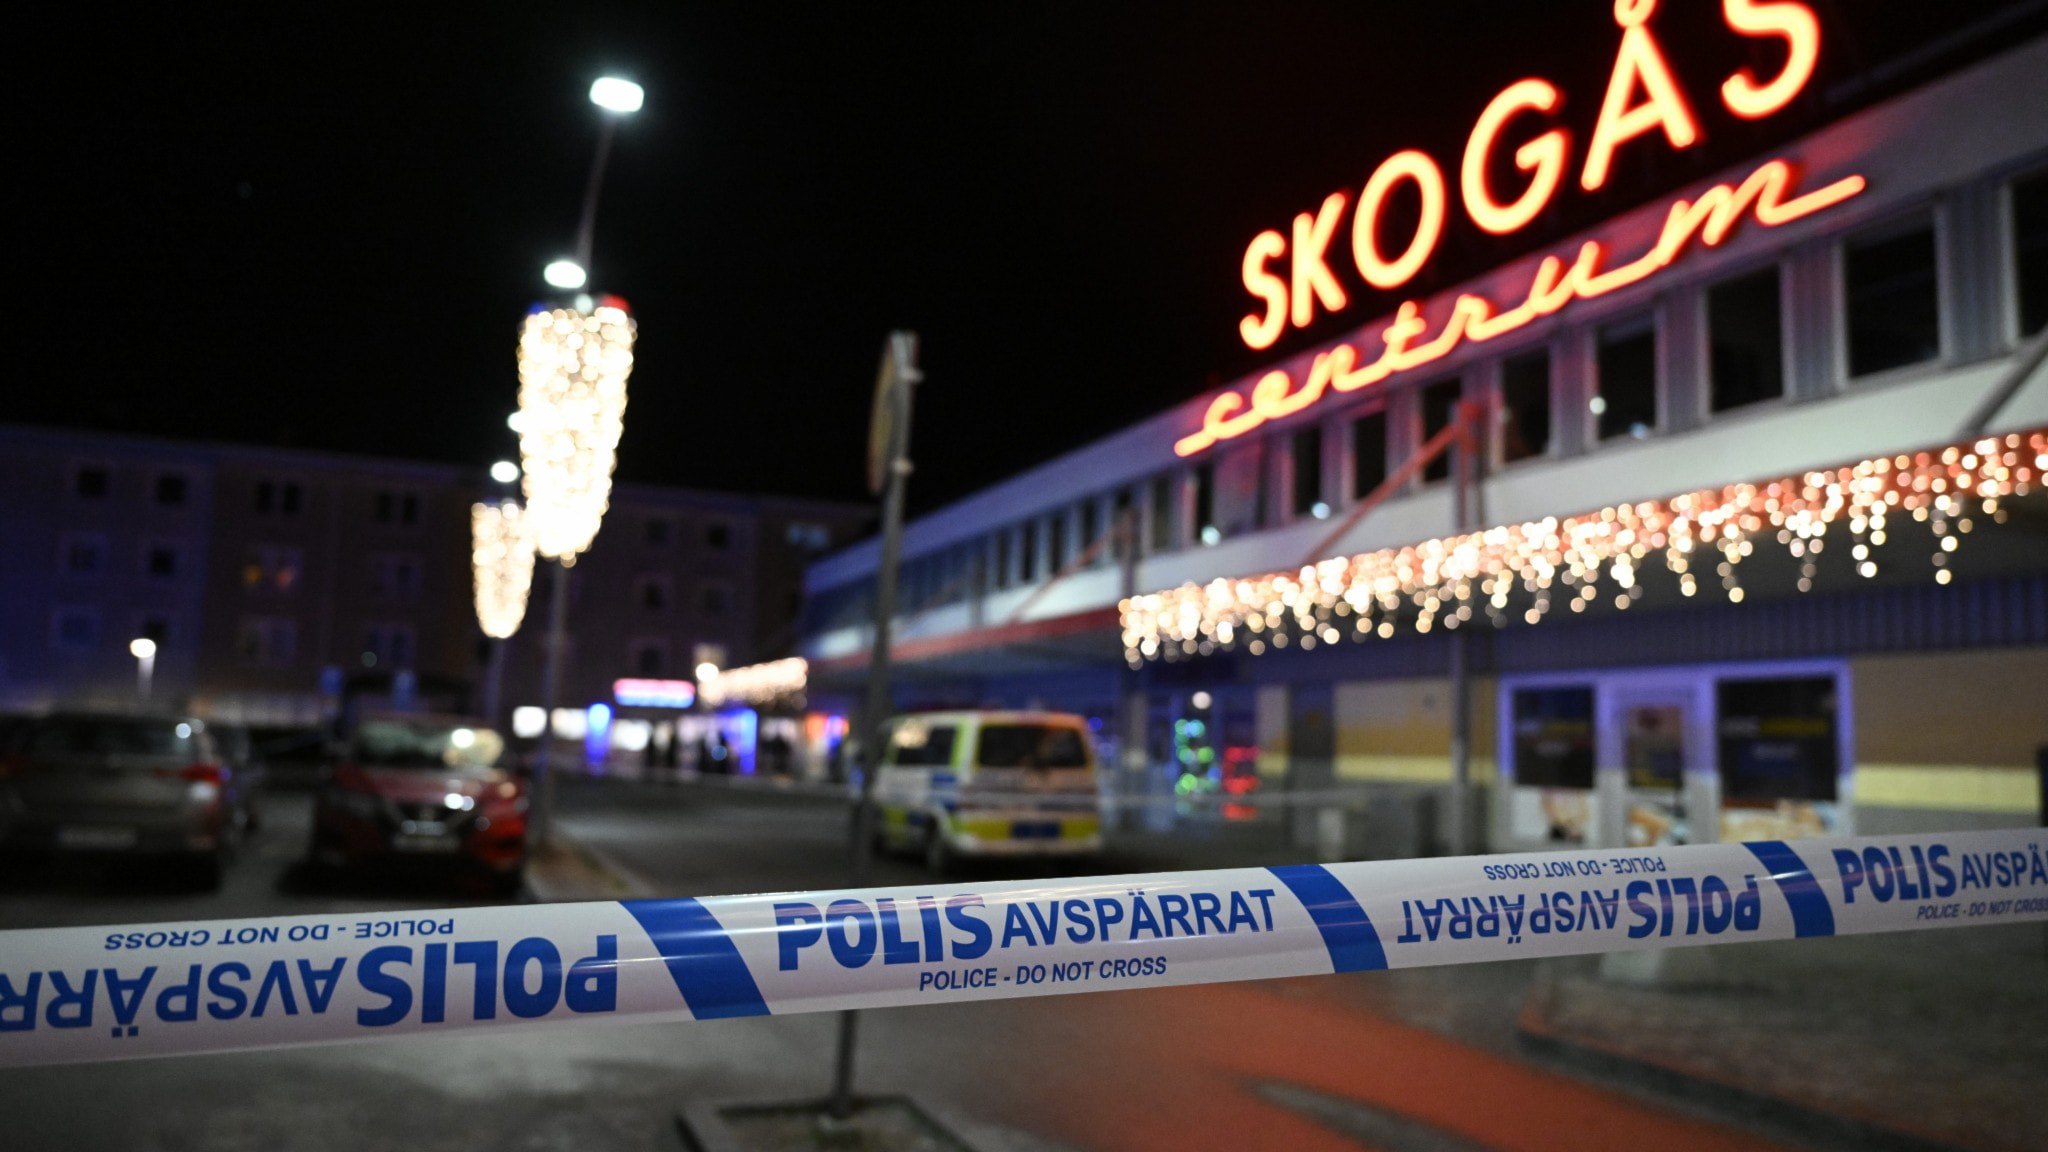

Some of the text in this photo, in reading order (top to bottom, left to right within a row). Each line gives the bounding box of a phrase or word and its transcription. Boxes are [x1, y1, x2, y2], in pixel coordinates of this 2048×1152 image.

[1240, 0, 1820, 350] SKOGÅS
[1174, 158, 1866, 457] centrum
[1483, 864, 1541, 881] CROSS
[1544, 861, 1573, 879] NOT
[1577, 860, 1599, 877] DO
[1614, 856, 1667, 874] POLICE
[1831, 843, 2048, 904] POLIS AVSPÄ
[1398, 874, 1760, 945] POLIS AVSPÄRRAT
[1917, 902, 1960, 920] POLICE
[1969, 902, 1986, 916] DO
[1988, 898, 2012, 915] NOT
[217, 927, 280, 946] NOT
[288, 923, 330, 942] DO
[356, 918, 455, 940] POLICE
[773, 887, 1276, 971] POLIS AVSPÄRRAT
[104, 930, 212, 951] CROSS
[356, 934, 619, 1027] POLIS
[919, 964, 998, 991] POLICE
[1016, 963, 1046, 985] DO
[1051, 959, 1093, 983] NOT
[1099, 955, 1168, 979] CROSS
